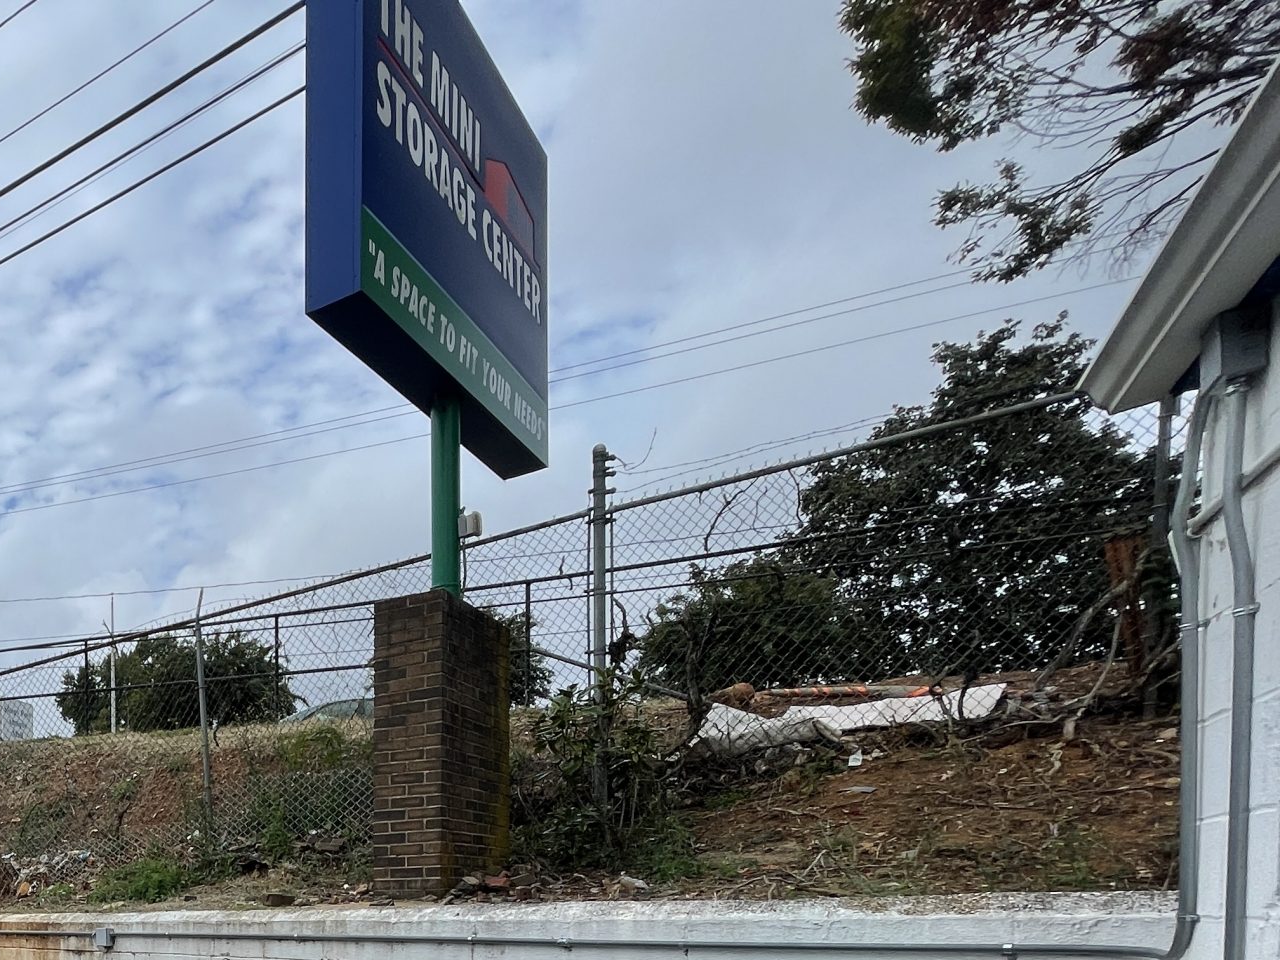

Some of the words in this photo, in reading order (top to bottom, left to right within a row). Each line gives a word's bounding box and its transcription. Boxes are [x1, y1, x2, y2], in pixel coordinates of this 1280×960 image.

[430, 51, 481, 173] MINI
[376, 60, 477, 241] STORAGE
[482, 209, 540, 325] CENTER
[391, 266, 436, 334] SPACE
[440, 313, 456, 353] TO
[460, 335, 479, 375] FIT
[483, 358, 511, 411] YOUR
